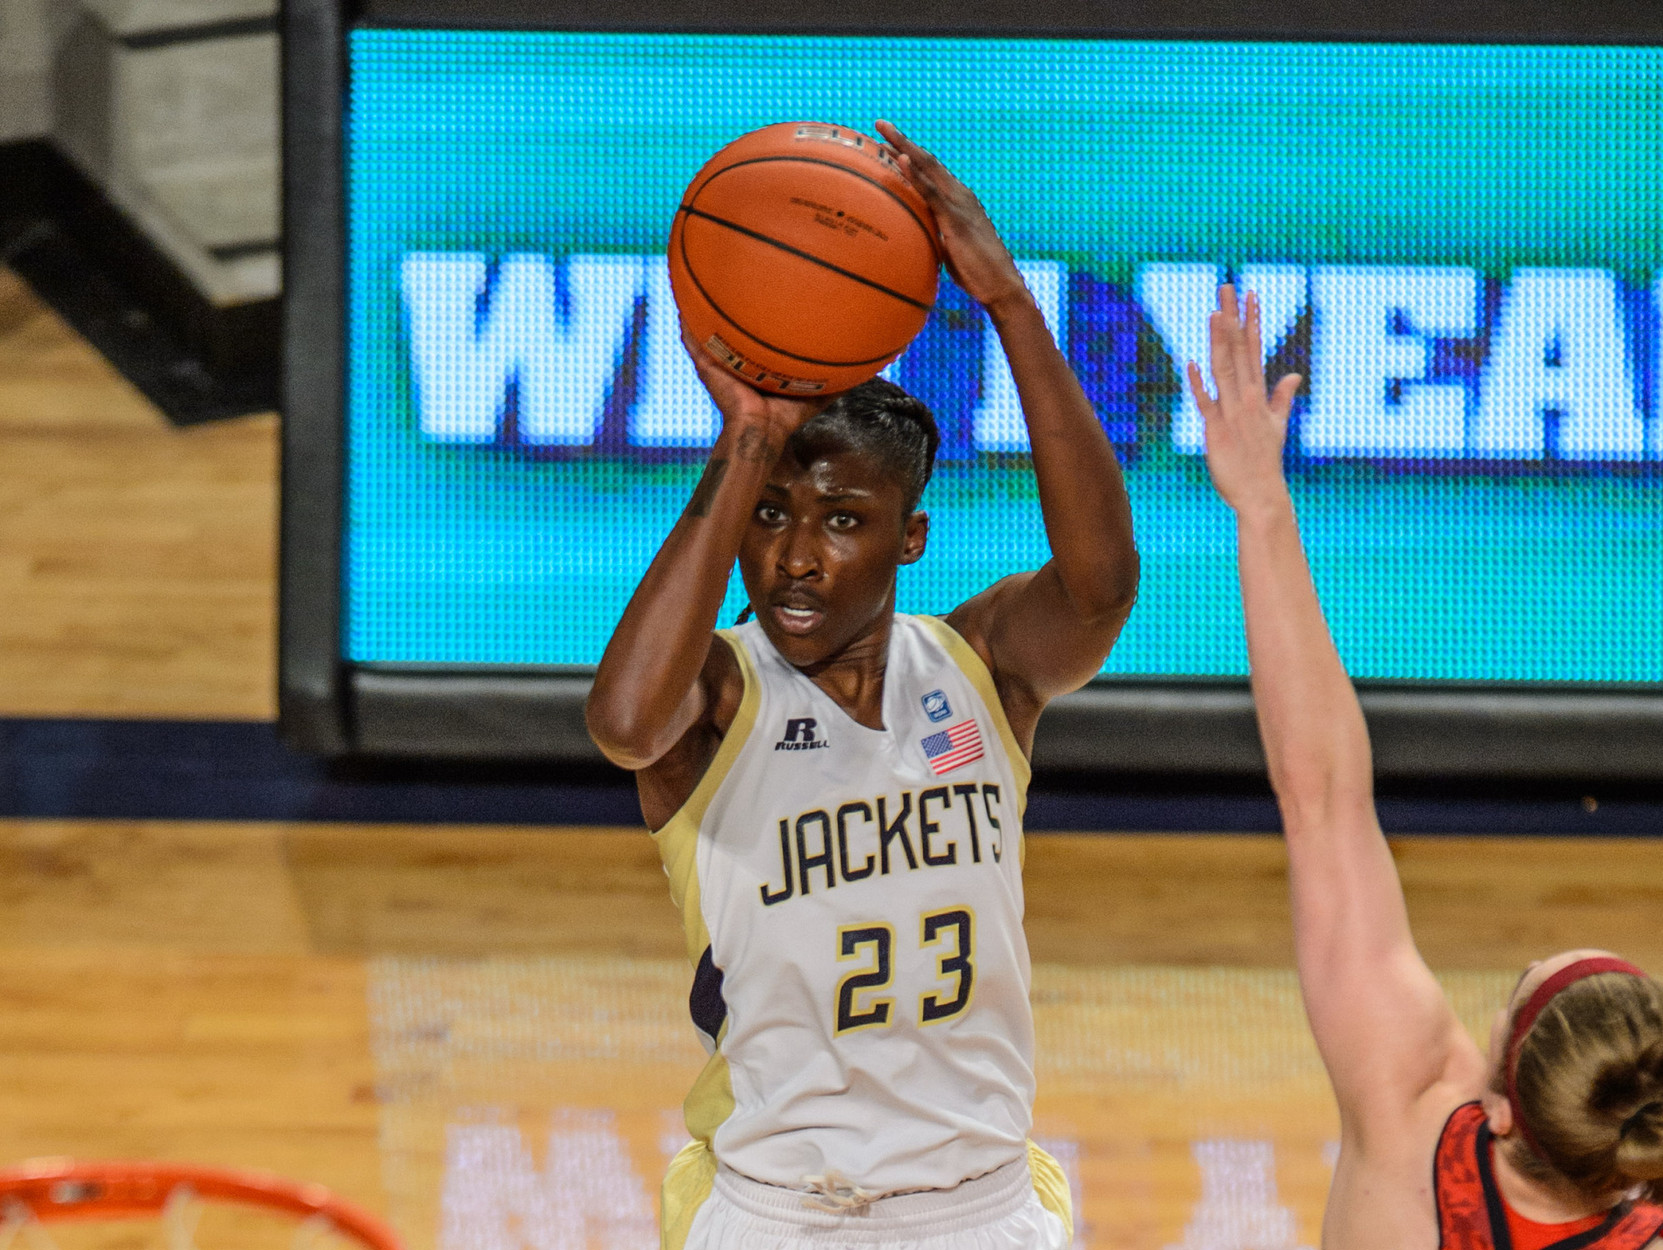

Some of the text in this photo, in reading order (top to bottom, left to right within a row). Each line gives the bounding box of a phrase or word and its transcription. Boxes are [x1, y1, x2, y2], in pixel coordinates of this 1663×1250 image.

[1135, 261, 1663, 461] YEA
[774, 740, 830, 751] RUSSELL
[758, 780, 1003, 907] JACKETS
[833, 904, 978, 1038] 23
